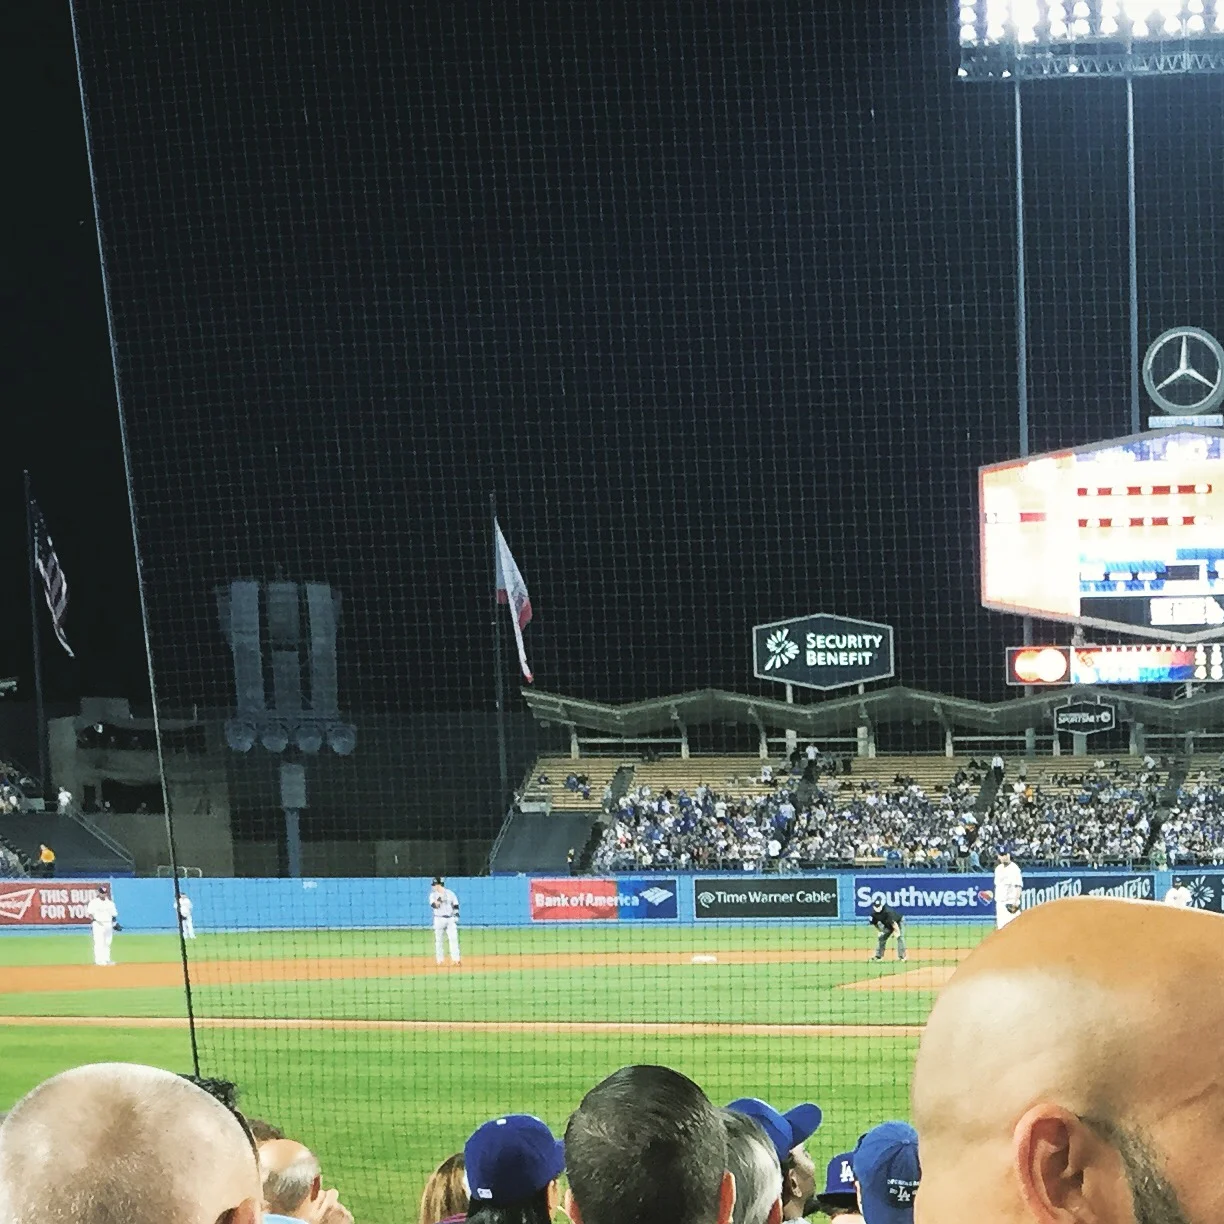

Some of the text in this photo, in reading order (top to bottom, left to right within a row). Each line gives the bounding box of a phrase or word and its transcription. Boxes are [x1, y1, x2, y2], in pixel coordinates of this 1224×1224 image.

[806, 633, 883, 649] SECURITY
[806, 650, 873, 666] BENEFIT
[39, 889, 69, 904] THIS
[535, 893, 640, 907] Bank of America
[715, 890, 831, 903] Time Warner Cable
[857, 886, 977, 908] Southwest
[40, 904, 66, 919] FOR
[840, 1161, 854, 1182] LA
[897, 1186, 910, 1201] LA
